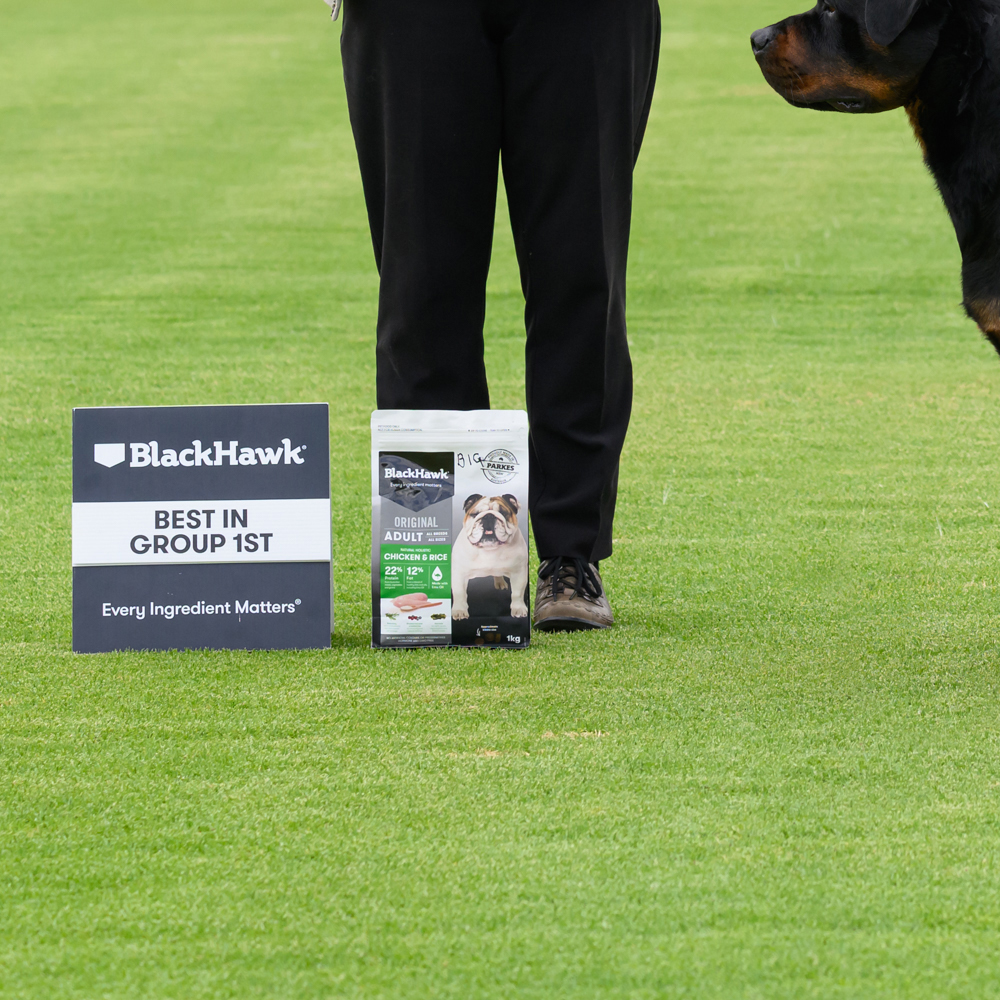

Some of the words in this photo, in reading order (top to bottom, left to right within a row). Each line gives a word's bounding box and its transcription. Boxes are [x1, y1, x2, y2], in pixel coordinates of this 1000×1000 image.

[486, 462, 515, 471] PARKES
[154, 509, 216, 530] BEST
[222, 508, 249, 529] IN
[394, 516, 439, 528] ORIGINAL
[384, 531, 424, 542] ADULT
[130, 534, 226, 555] GROUP
[232, 532, 274, 553] 1ST
[384, 552, 421, 561] CHICKEN
[422, 553, 428, 561] &
[429, 553, 448, 561] RICE
[384, 566, 403, 576] 22%
[406, 566, 424, 576] 12%
[102, 602, 146, 620] Every
[149, 600, 231, 620] Ingredient
[506, 634, 521, 644] 1kg
